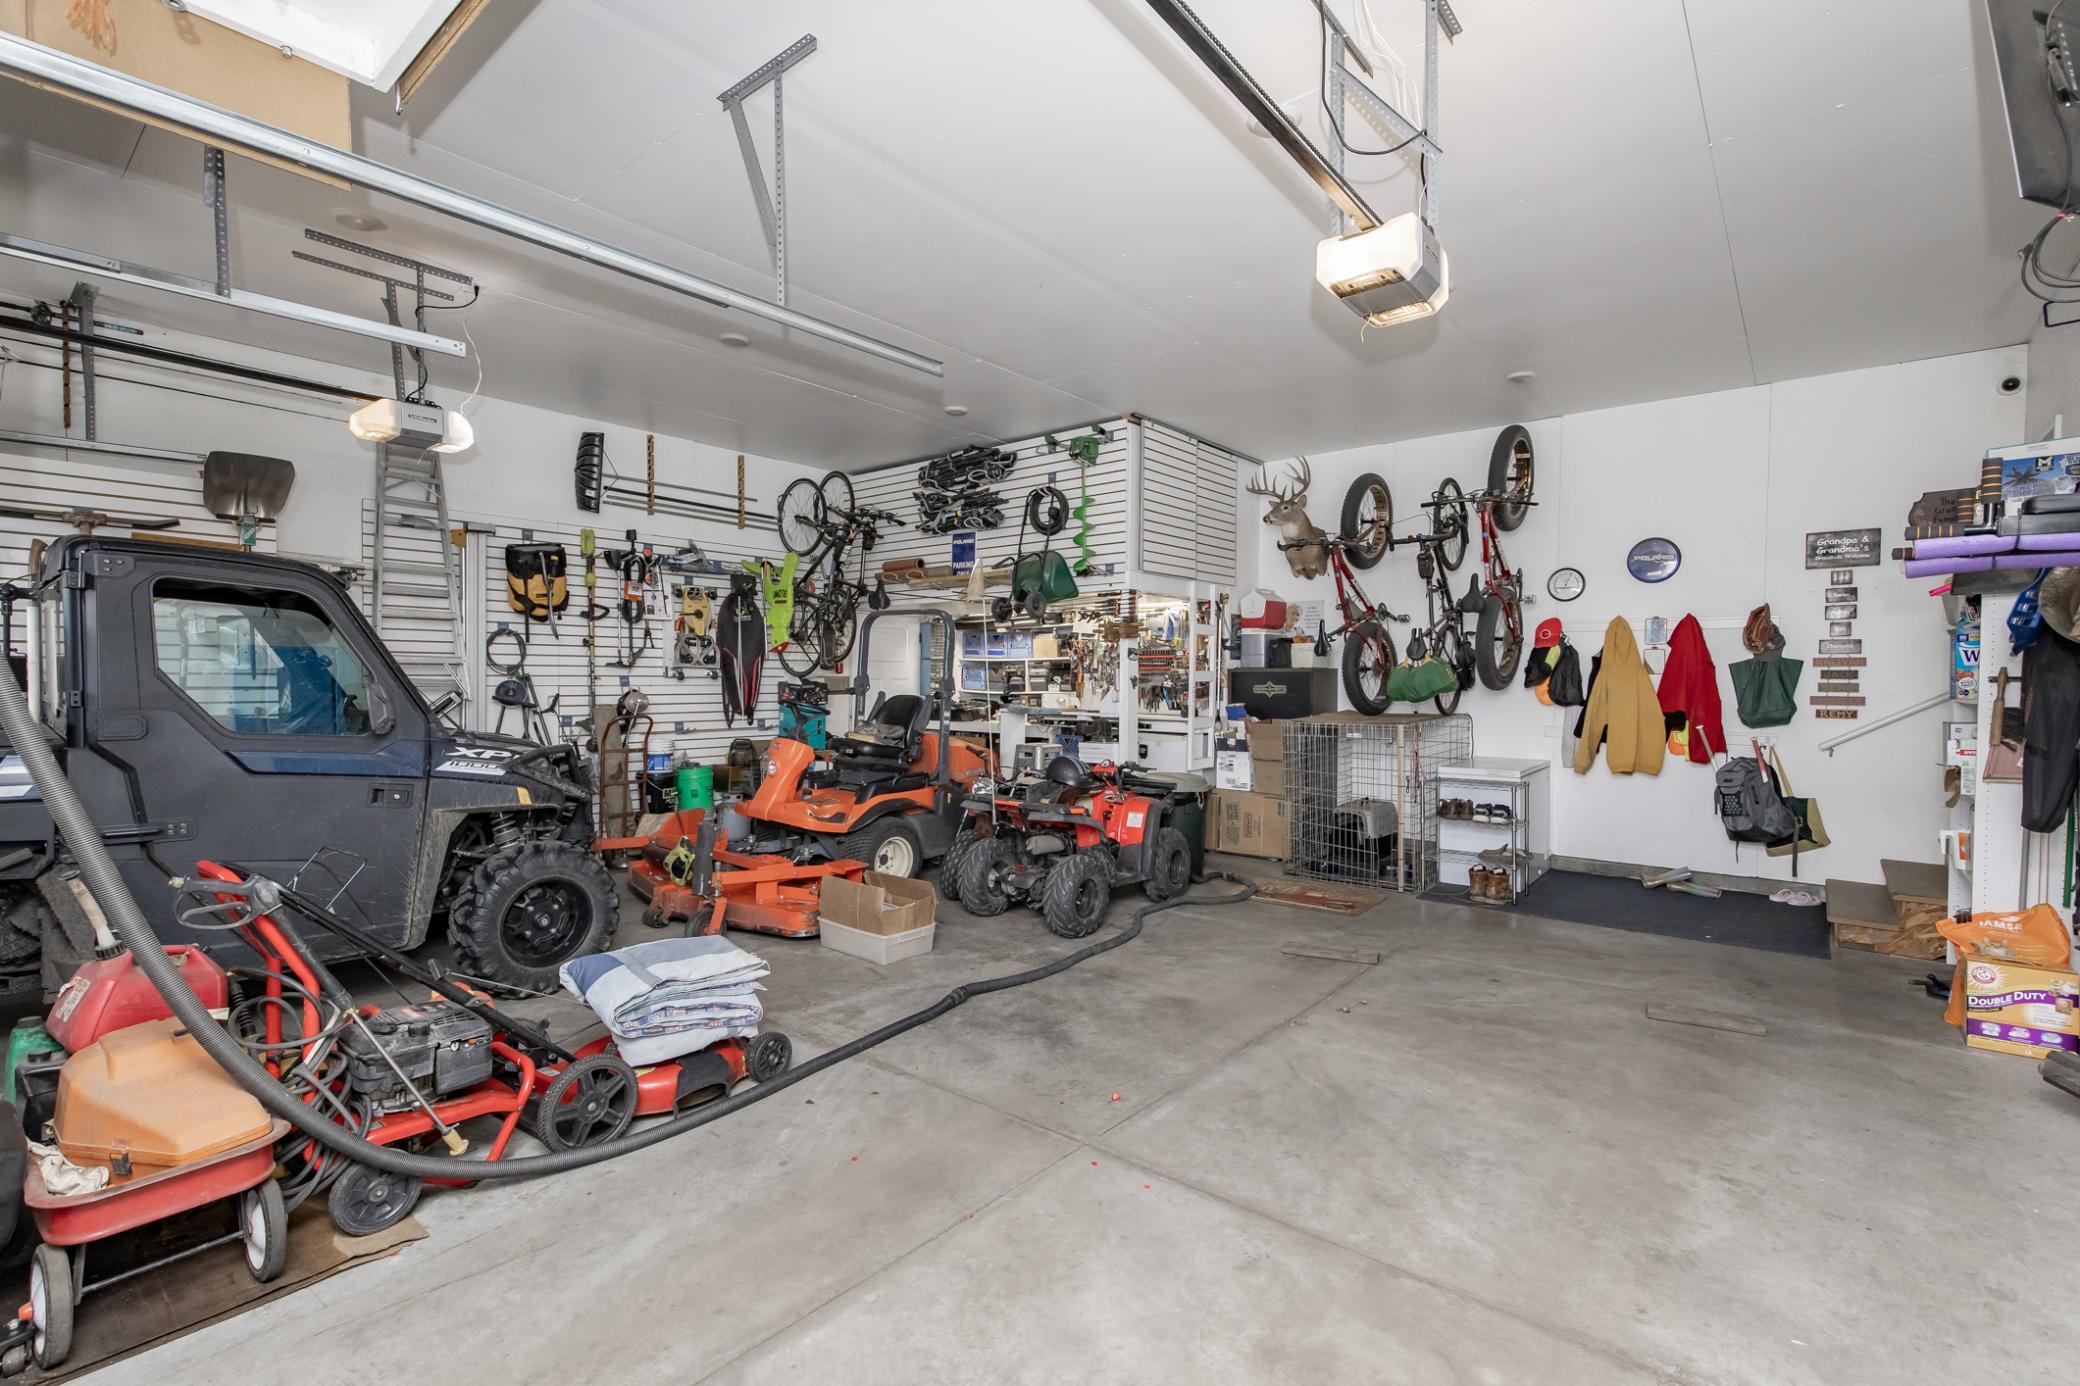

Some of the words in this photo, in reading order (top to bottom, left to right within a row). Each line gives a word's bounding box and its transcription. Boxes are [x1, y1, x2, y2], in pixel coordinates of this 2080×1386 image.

[1816, 536, 1858, 546] Grandpa
[1861, 535, 1869, 543] &
[1816, 544, 1870, 555] Grandma's
[952, 561, 975, 569] PARKING
[1968, 994, 2013, 1006] DOUBLE
[2014, 991, 2047, 1001] DUTY
